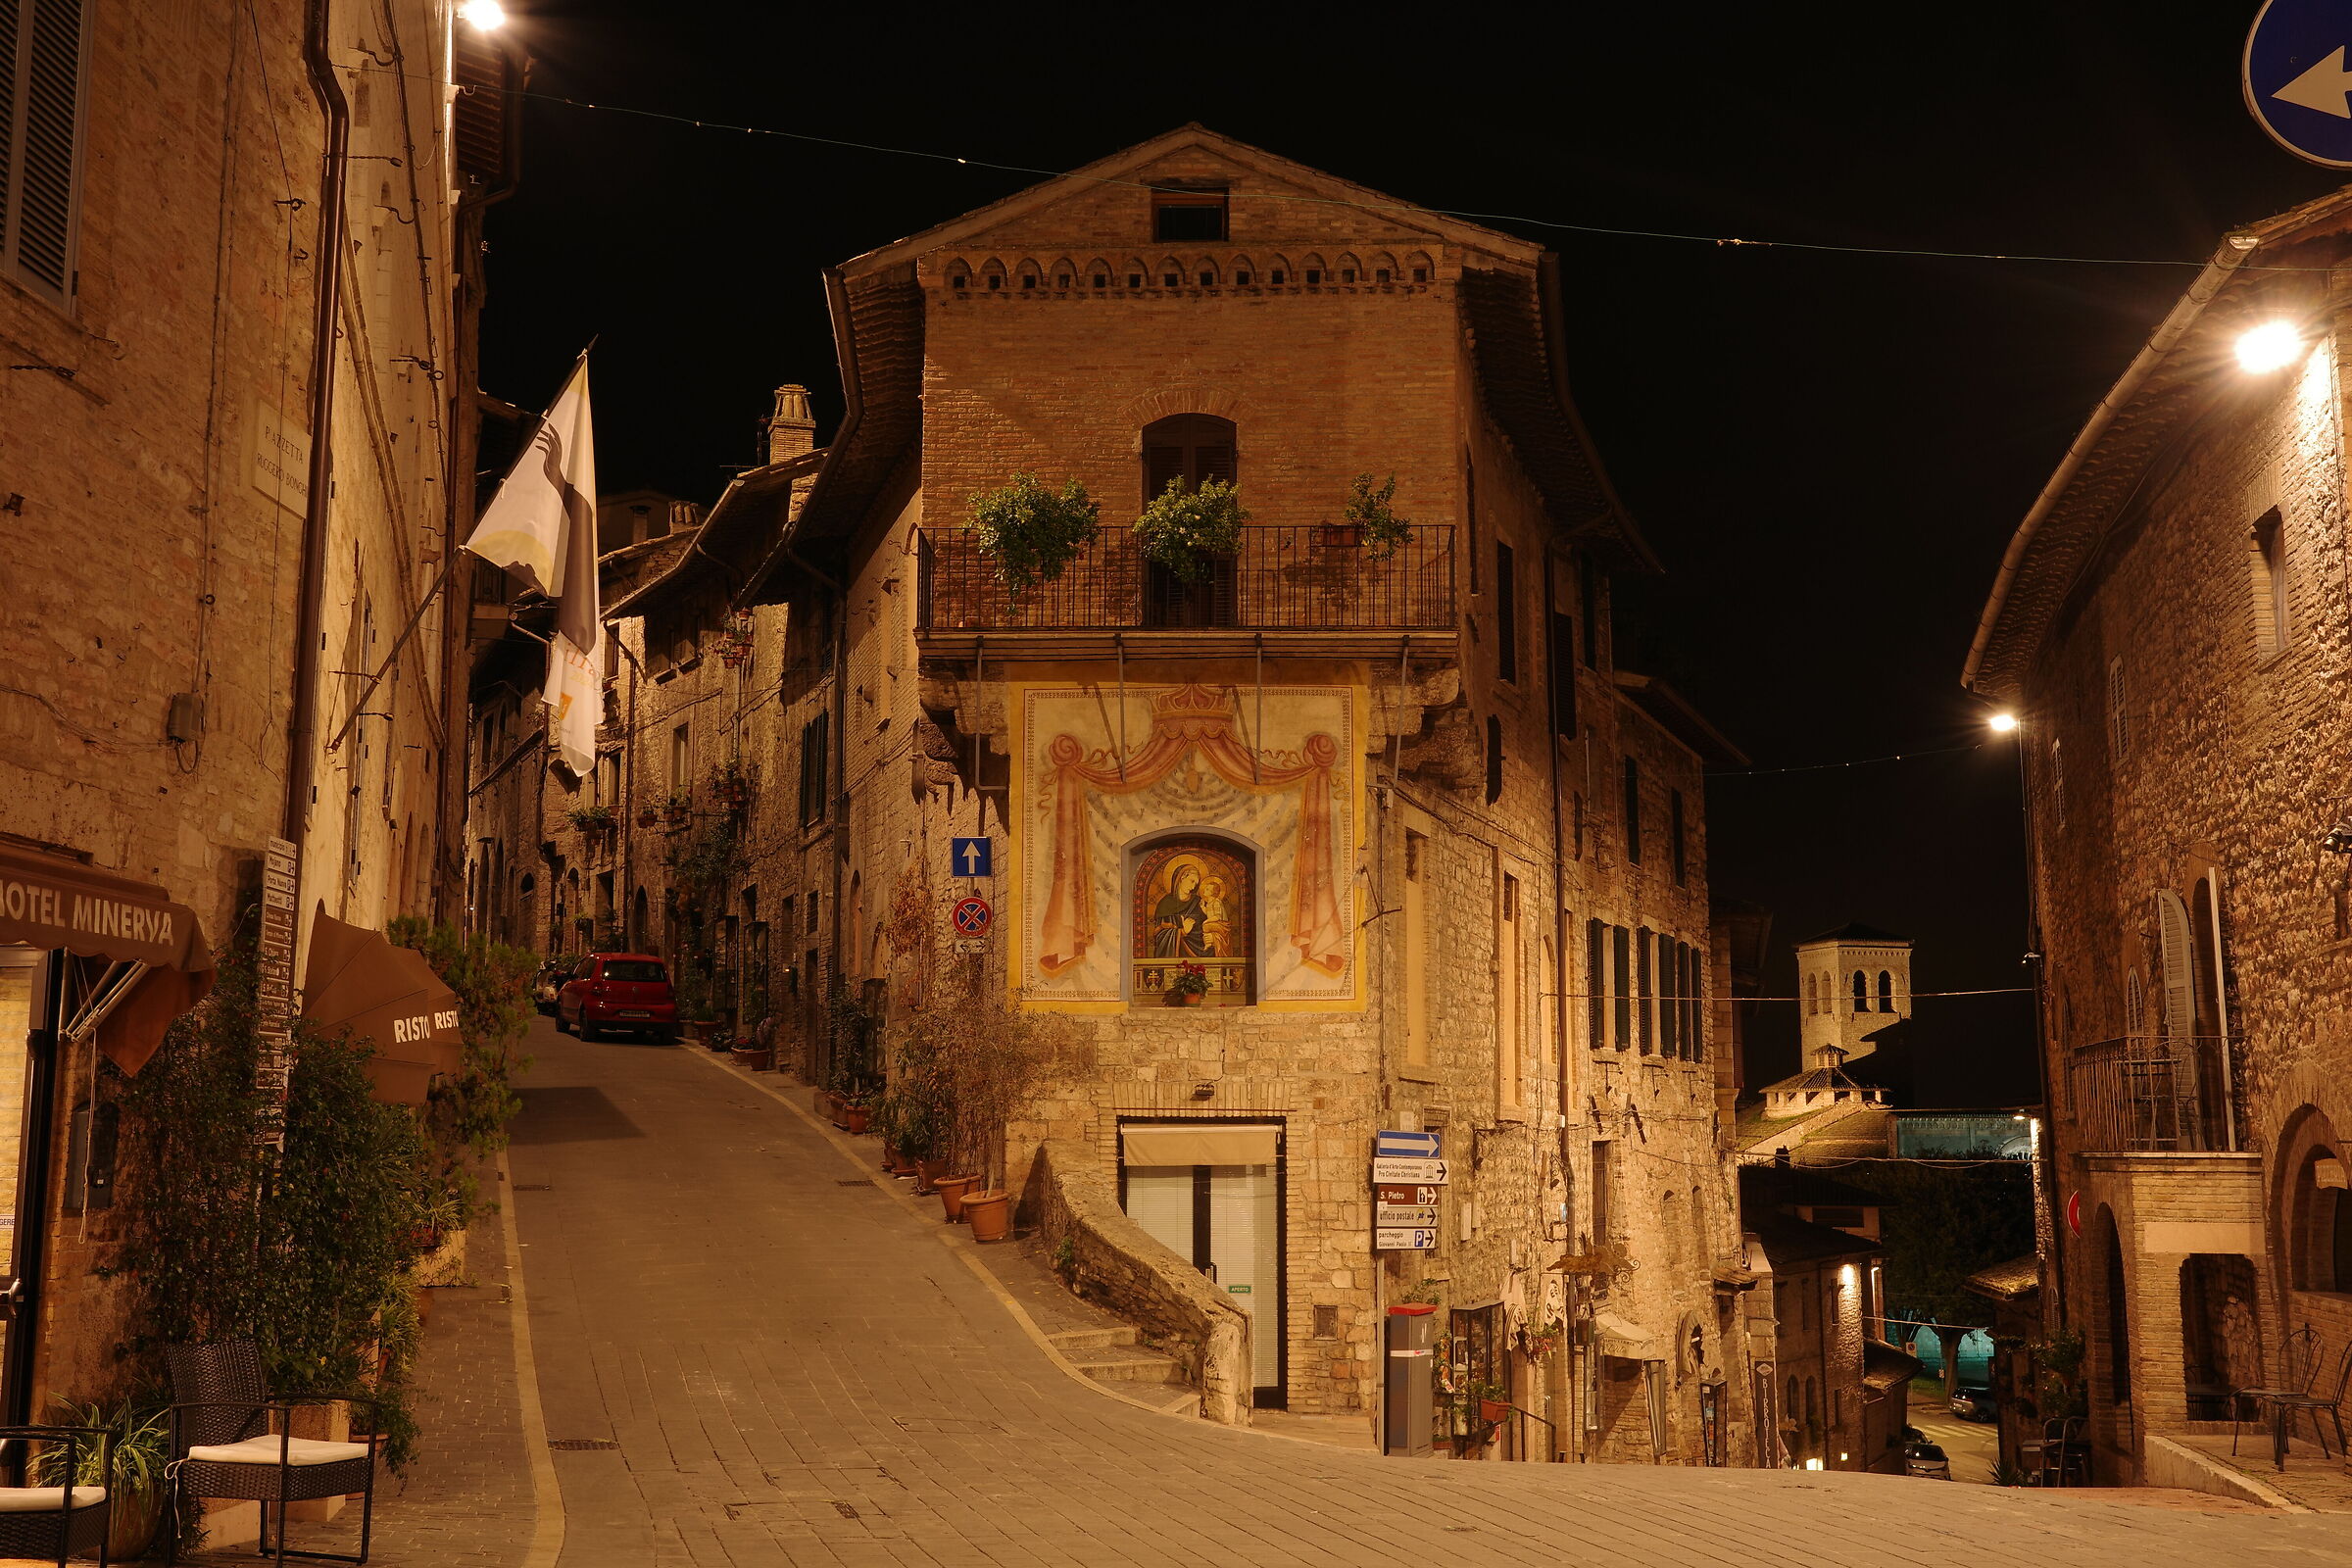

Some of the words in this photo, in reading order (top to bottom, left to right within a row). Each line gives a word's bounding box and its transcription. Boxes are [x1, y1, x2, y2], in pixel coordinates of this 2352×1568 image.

[266, 425, 304, 465] PAZZETTA
[257, 453, 285, 481] RUGGERO
[285, 472, 307, 496] BONGH
[73, 894, 174, 946] MINERVA
[393, 1015, 431, 1044] RISTO
[1388, 1191, 1405, 1200] Pietro
[1380, 1210, 1395, 1220] ufficio
[1396, 1211, 1414, 1223] postale
[1379, 1231, 1403, 1240] parcheggio
[1762, 1378, 1772, 1469] BIRROTECA
